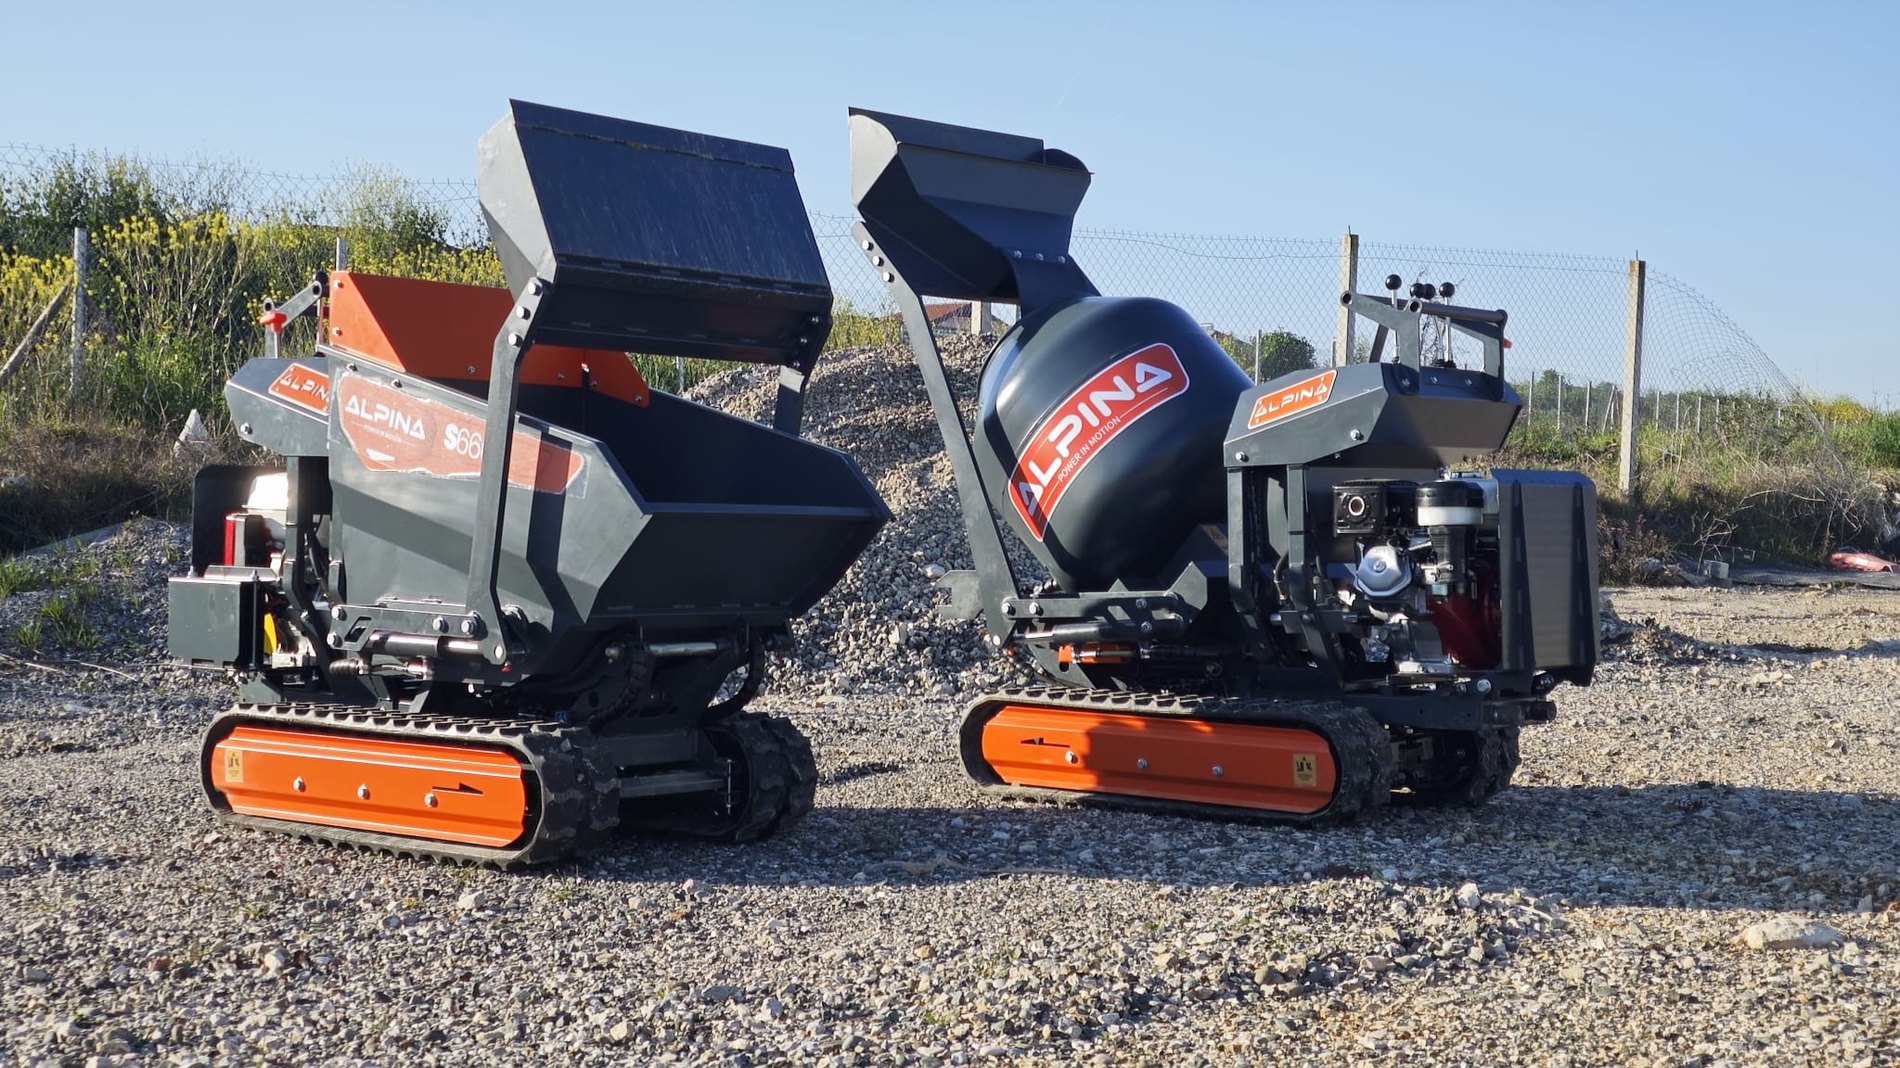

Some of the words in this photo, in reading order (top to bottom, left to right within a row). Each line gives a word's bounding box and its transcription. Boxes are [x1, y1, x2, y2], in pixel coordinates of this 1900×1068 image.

[280, 373, 330, 403] ALPIN
[1254, 382, 1328, 418] ALPINA
[345, 394, 426, 441] ALPINA
[443, 422, 485, 460] S66
[1018, 362, 1172, 516] ALPINA
[1057, 453, 1082, 483] POWER
[1079, 443, 1091, 456] IN
[1088, 415, 1122, 447] MOTION
